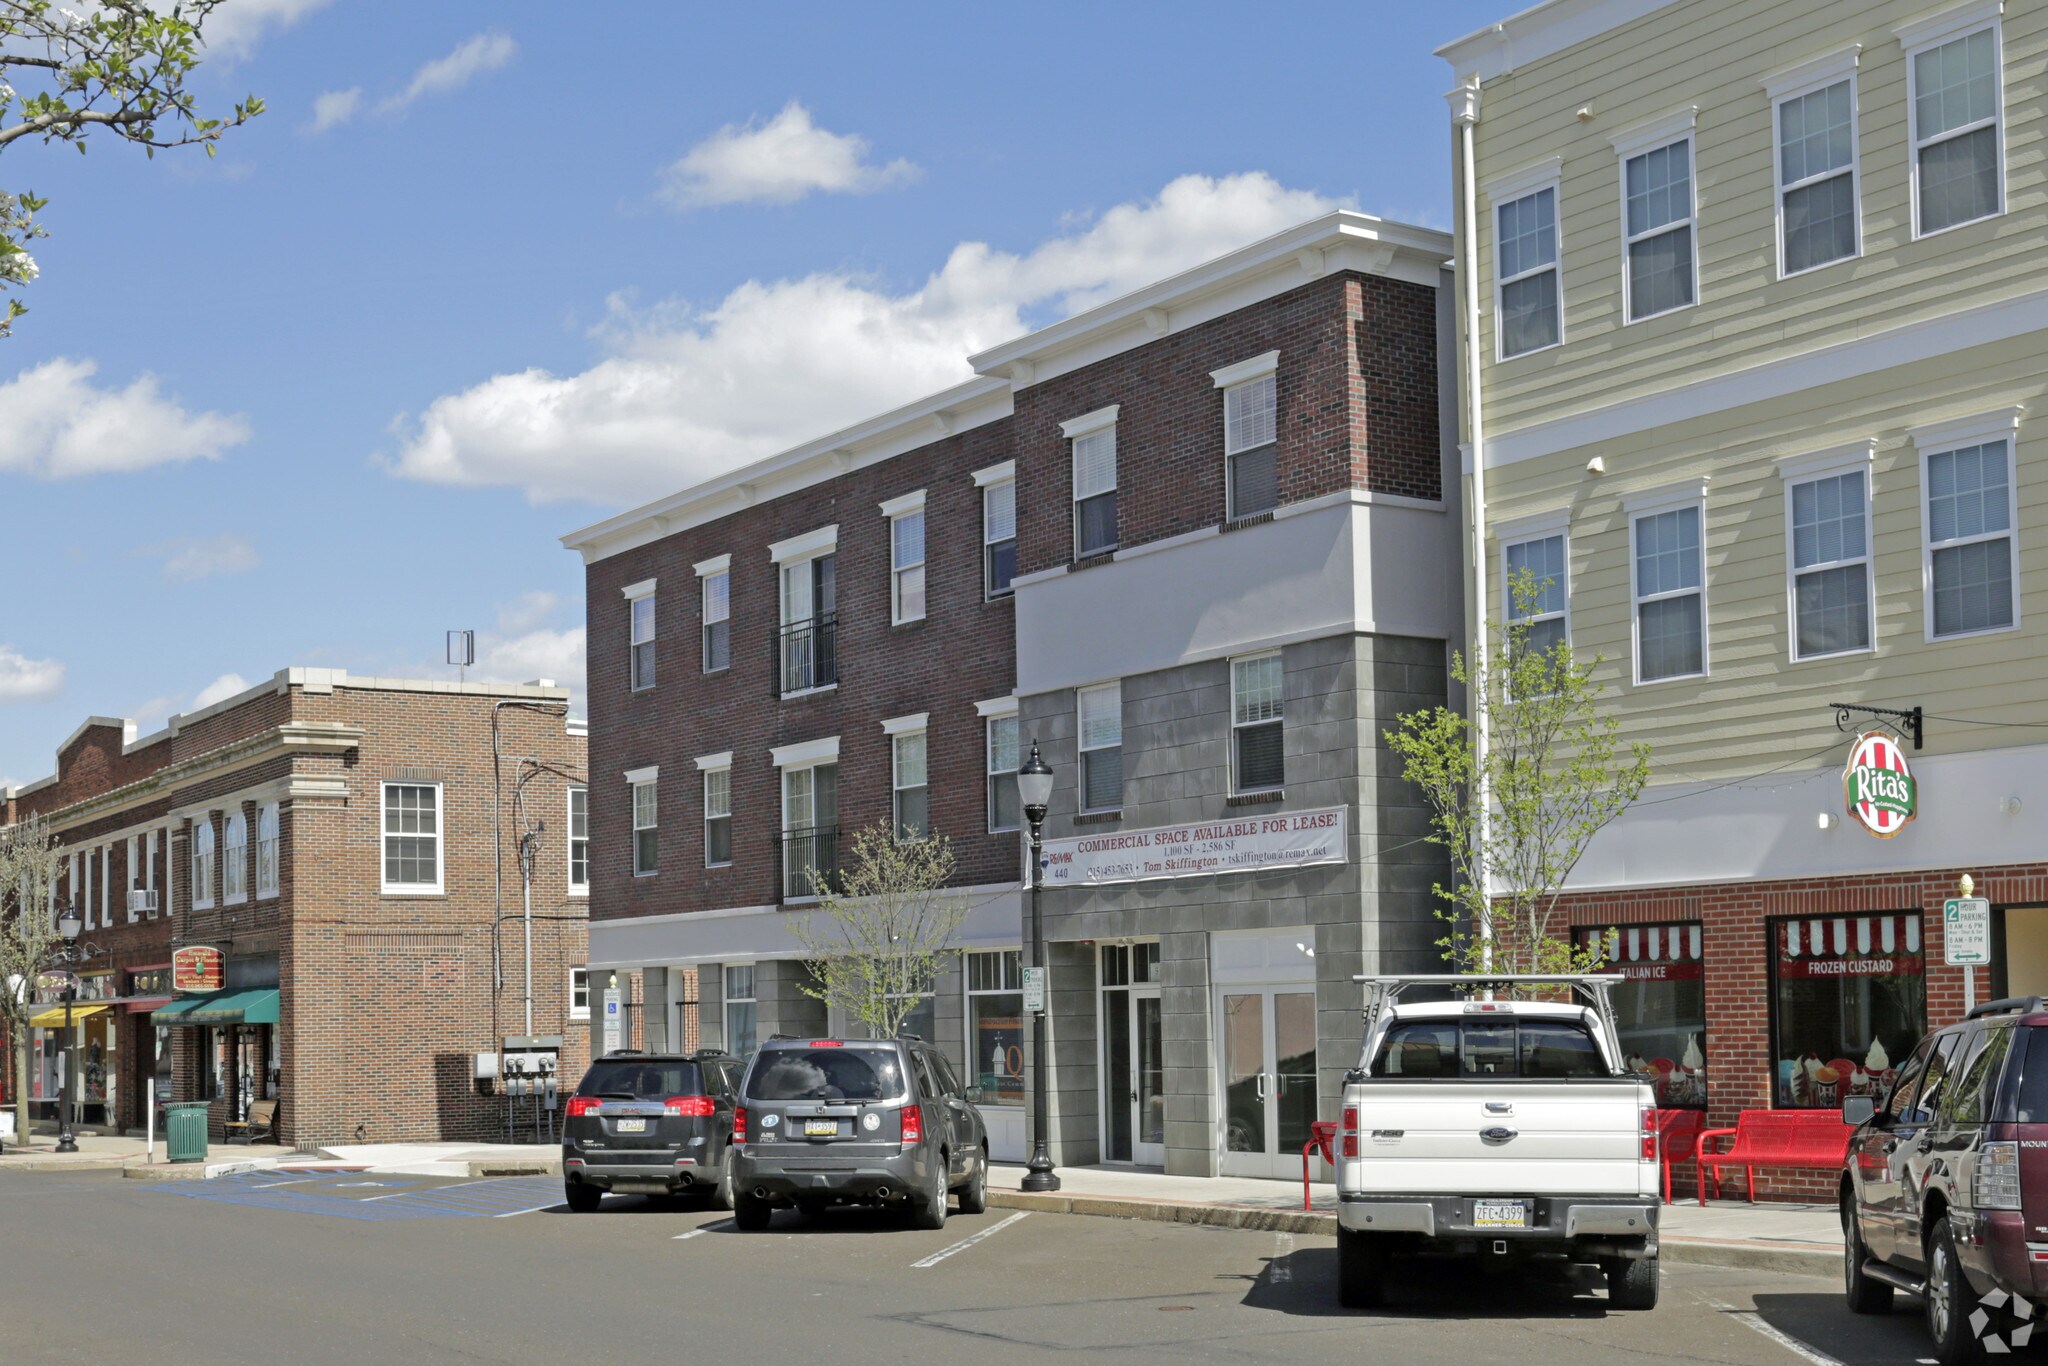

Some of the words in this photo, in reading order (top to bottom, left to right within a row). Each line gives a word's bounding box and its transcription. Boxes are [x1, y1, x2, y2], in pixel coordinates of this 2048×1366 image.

[1856, 765, 1909, 803] Rita's
[1077, 834, 1150, 854] COMMERCIAL
[1155, 830, 1188, 845] SPACE
[1193, 823, 1257, 841] AVAILABLE
[1262, 819, 1287, 833] FOR
[1293, 813, 1338, 830] LEASE!
[1184, 844, 1194, 855] SF
[1225, 840, 1236, 851] SF
[1049, 851, 1073, 865] RE/MAX
[1144, 862, 1161, 872] Tom
[1165, 857, 1217, 871] Skiffington
[1054, 868, 1068, 879] 440
[1948, 904, 1957, 921] 2
[1960, 903, 1977, 911] HOUR
[1960, 912, 1986, 921] PARKING
[1619, 966, 1651, 979] ITALIAN
[1652, 966, 1666, 978] ICE
[1808, 961, 1847, 975] FROZEN
[1848, 959, 1894, 973] CUSTARD
[1490, 1127, 1508, 1137] Ford
